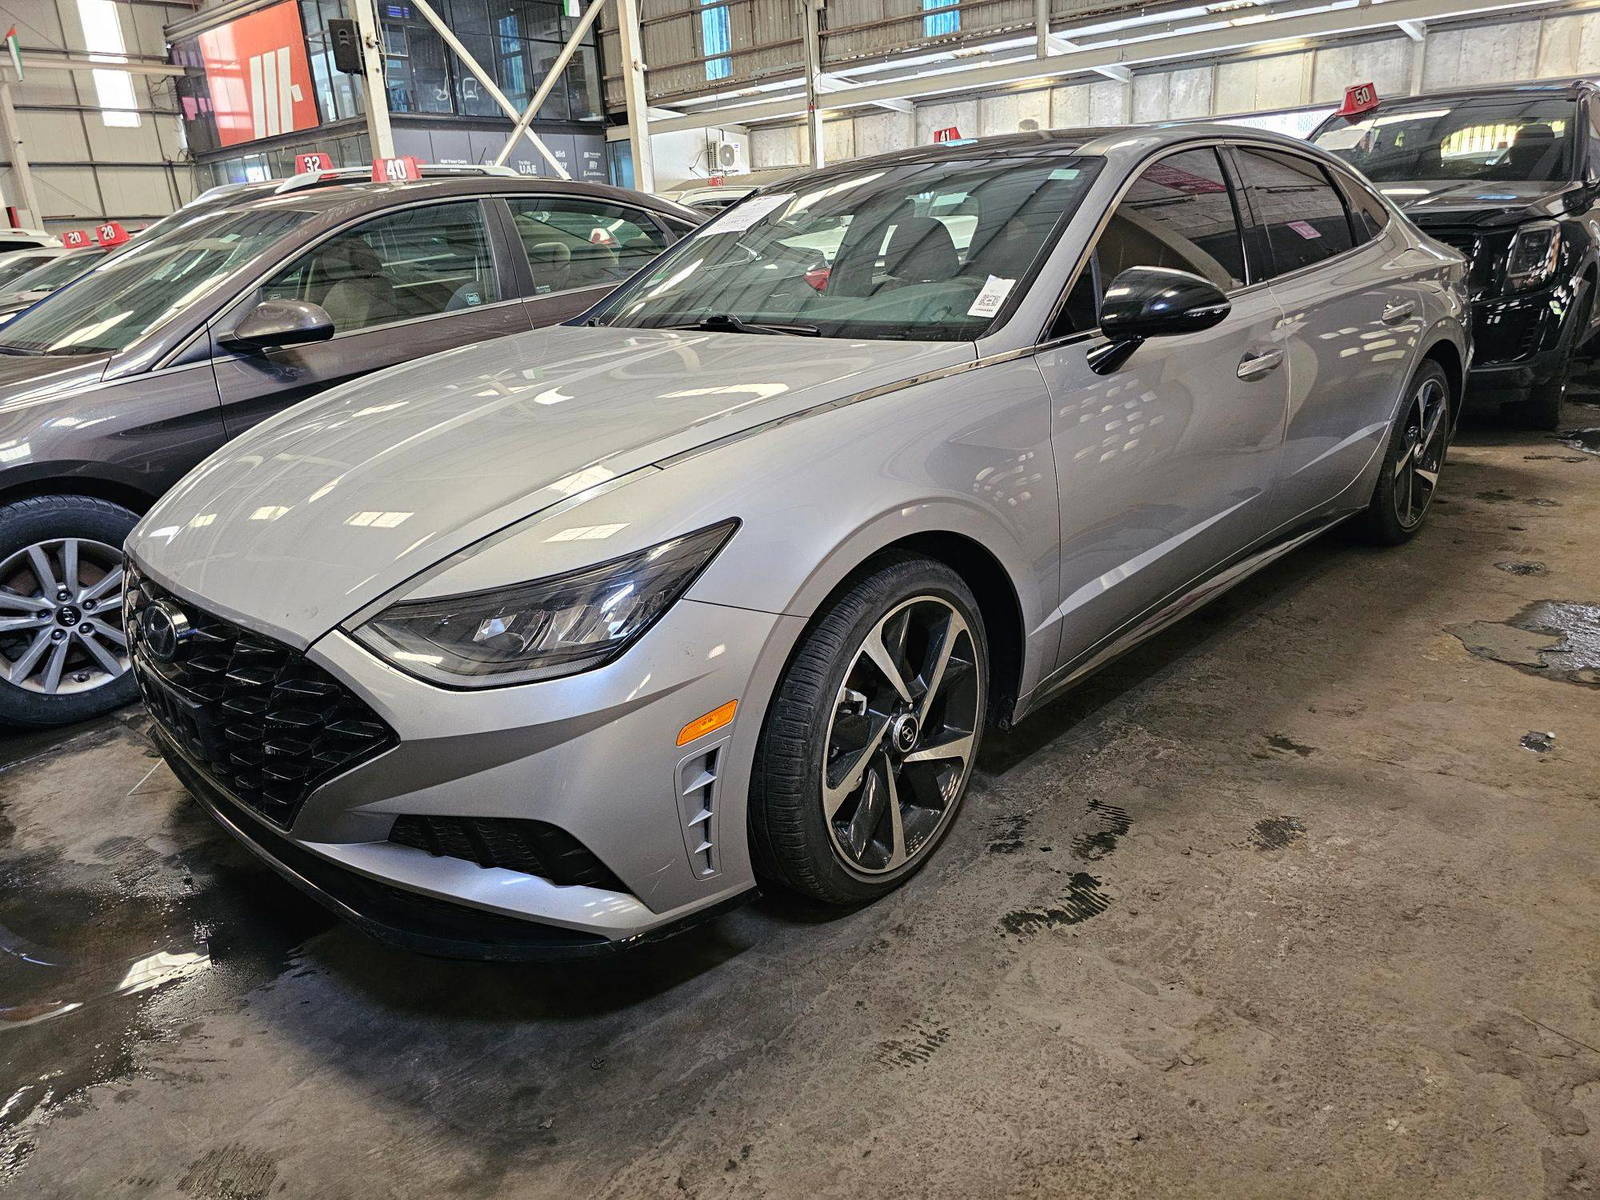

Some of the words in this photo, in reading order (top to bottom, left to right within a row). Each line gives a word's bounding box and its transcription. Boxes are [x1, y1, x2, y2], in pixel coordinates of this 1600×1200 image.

[1355, 87, 1371, 105] 50
[939, 129, 950, 141] 41
[304, 156, 322, 173] 32
[386, 159, 407, 180] 40
[519, 165, 537, 174] UAE
[68, 231, 82, 244] 20
[101, 225, 115, 240] 28
